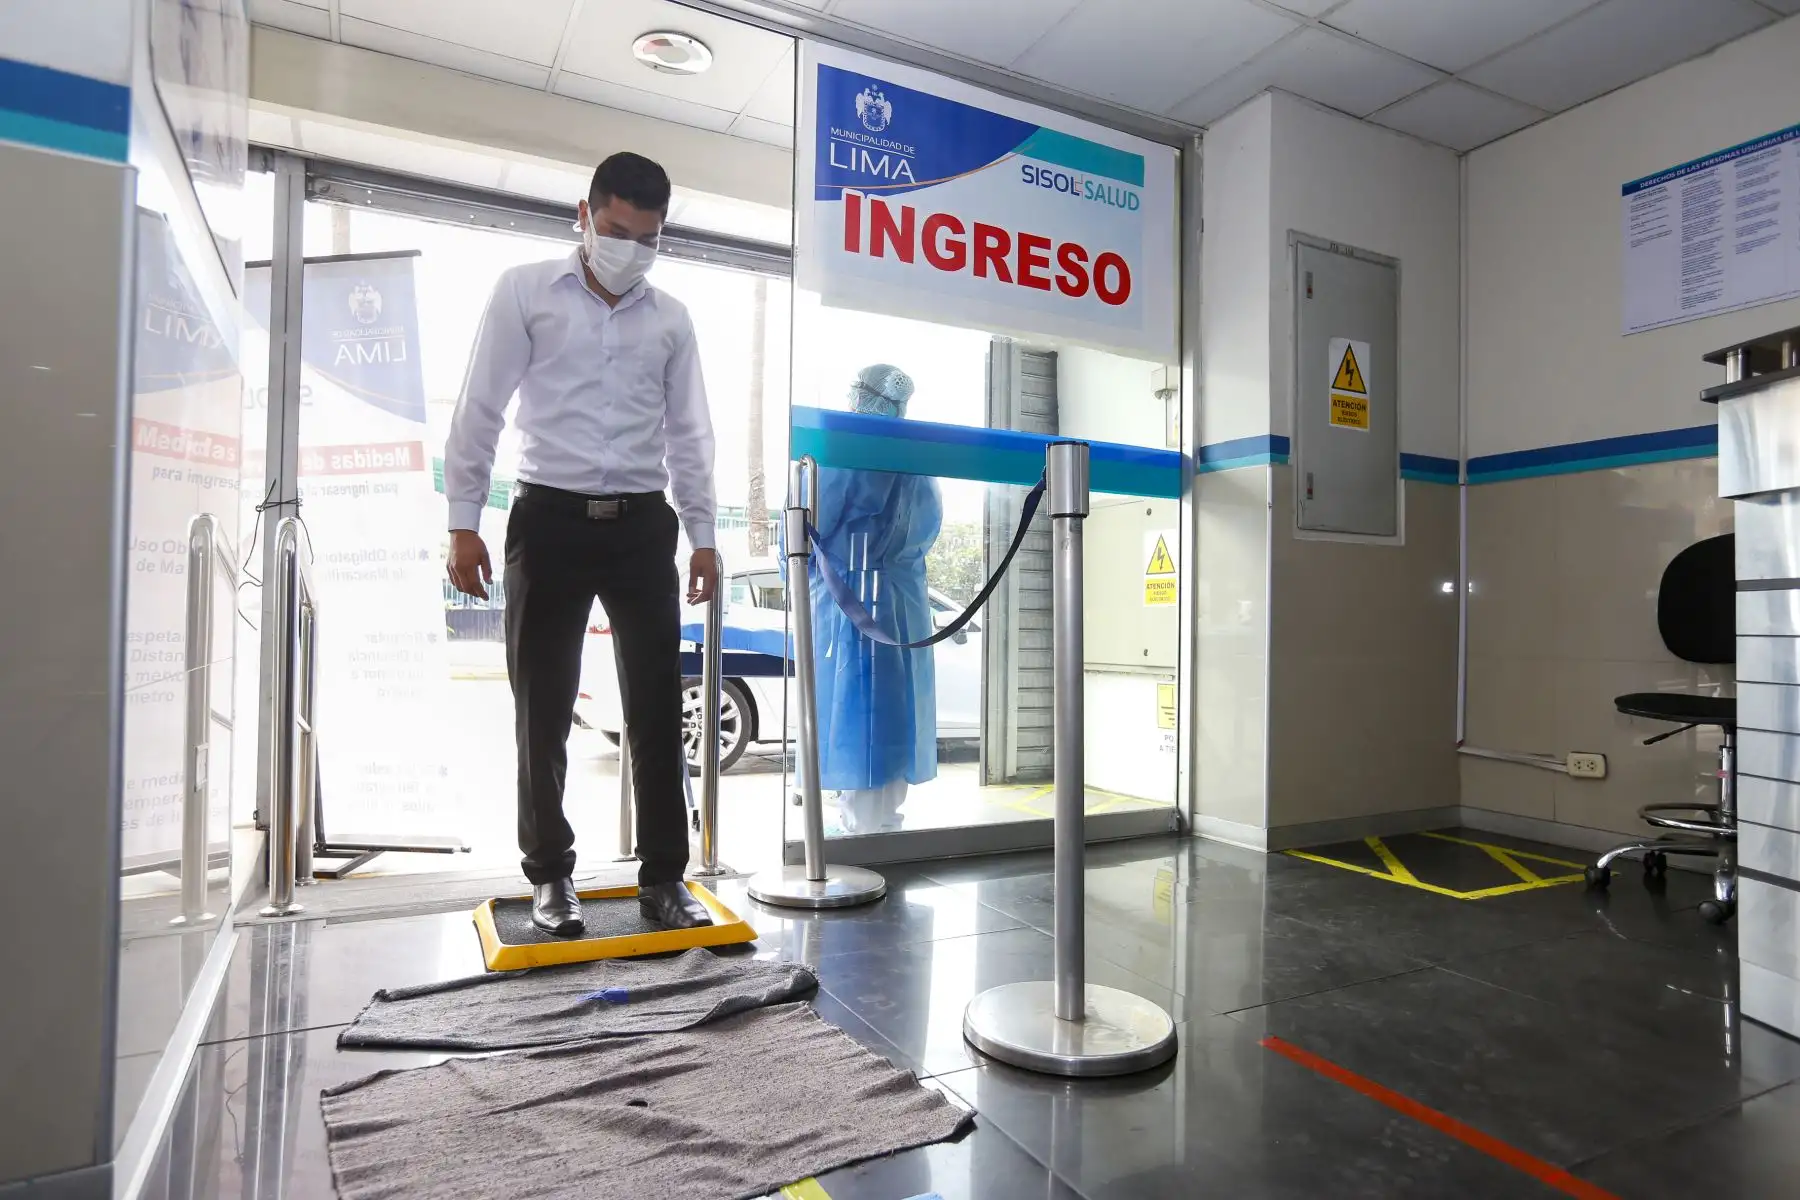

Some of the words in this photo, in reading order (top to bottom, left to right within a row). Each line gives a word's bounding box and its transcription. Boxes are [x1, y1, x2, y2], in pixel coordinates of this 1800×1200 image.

[830, 126, 902, 151] MUNICIPALIDAD
[903, 144, 915, 154] DE
[829, 142, 917, 184] LIMA
[1639, 172, 1676, 188] DERECHOS
[1676, 168, 1686, 177] DE
[1687, 163, 1701, 173] LAS
[1701, 149, 1740, 168] PERSONAS
[1741, 135, 1782, 154] USUARIAS
[844, 193, 1132, 306] INGRESO
[138, 424, 237, 462] Medidas
[152, 466, 182, 481] para
